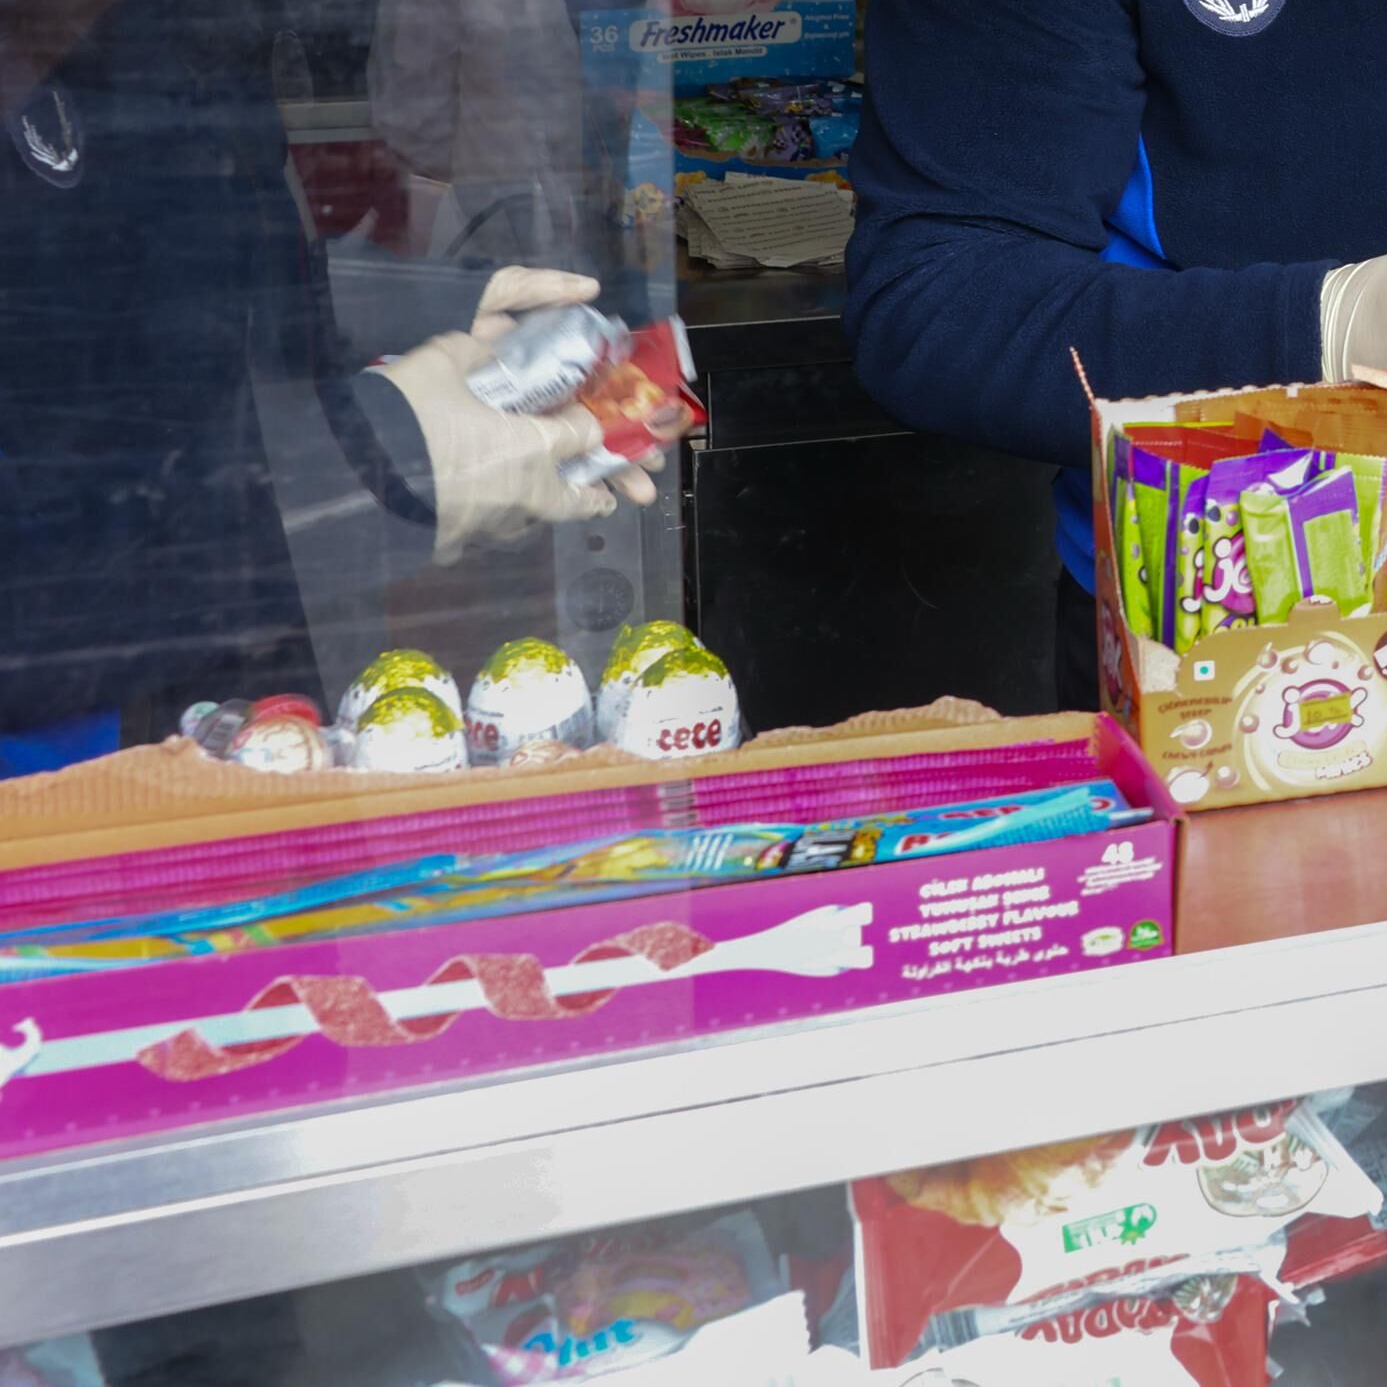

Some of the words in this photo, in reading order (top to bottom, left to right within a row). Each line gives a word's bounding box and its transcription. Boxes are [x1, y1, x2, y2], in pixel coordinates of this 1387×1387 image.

[589, 25, 620, 44] 36
[639, 14, 786, 48] Freshmaker
[656, 718, 722, 752] cece
